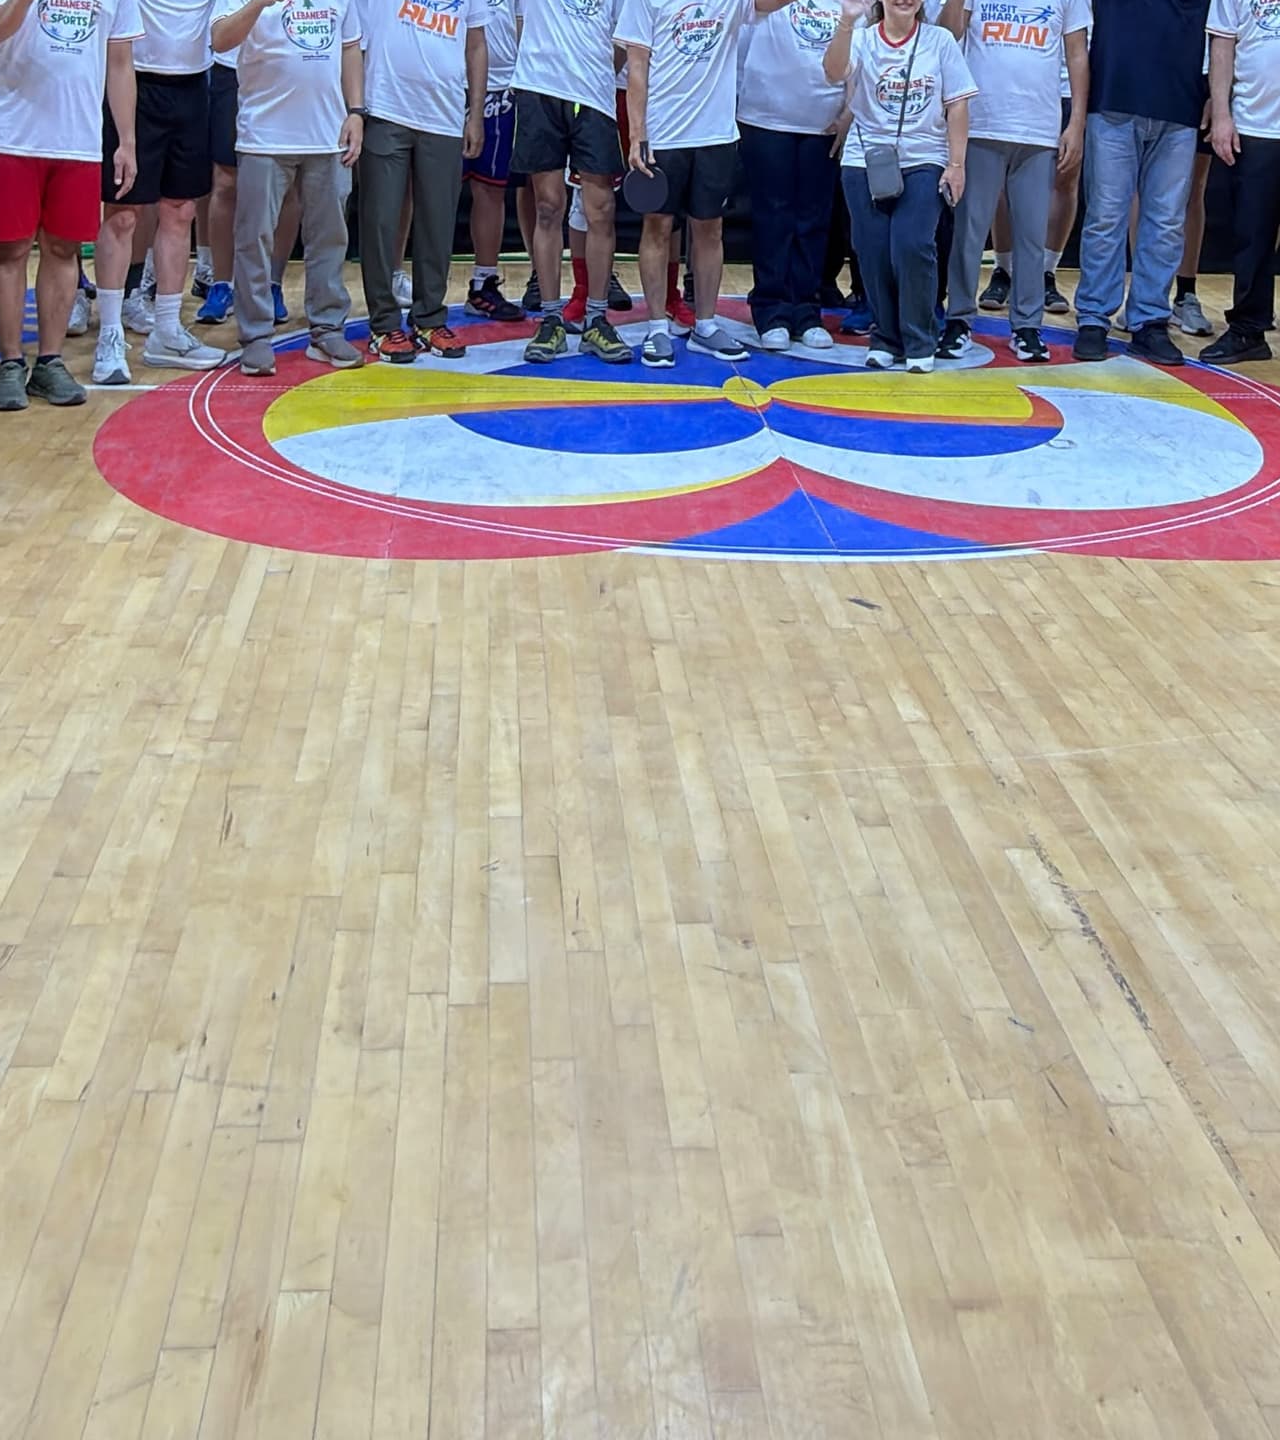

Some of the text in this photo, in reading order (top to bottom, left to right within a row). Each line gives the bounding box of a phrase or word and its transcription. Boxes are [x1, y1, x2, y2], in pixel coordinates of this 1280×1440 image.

[981, 4, 1018, 13] VIKSIT
[50, 13, 88, 26] SPORTS
[292, 10, 329, 20] LEBANESE
[398, 0, 459, 37] RUN
[981, 13, 1028, 24] BHARAT
[297, 25, 329, 34] SPORTS
[982, 22, 1049, 47] RUN
